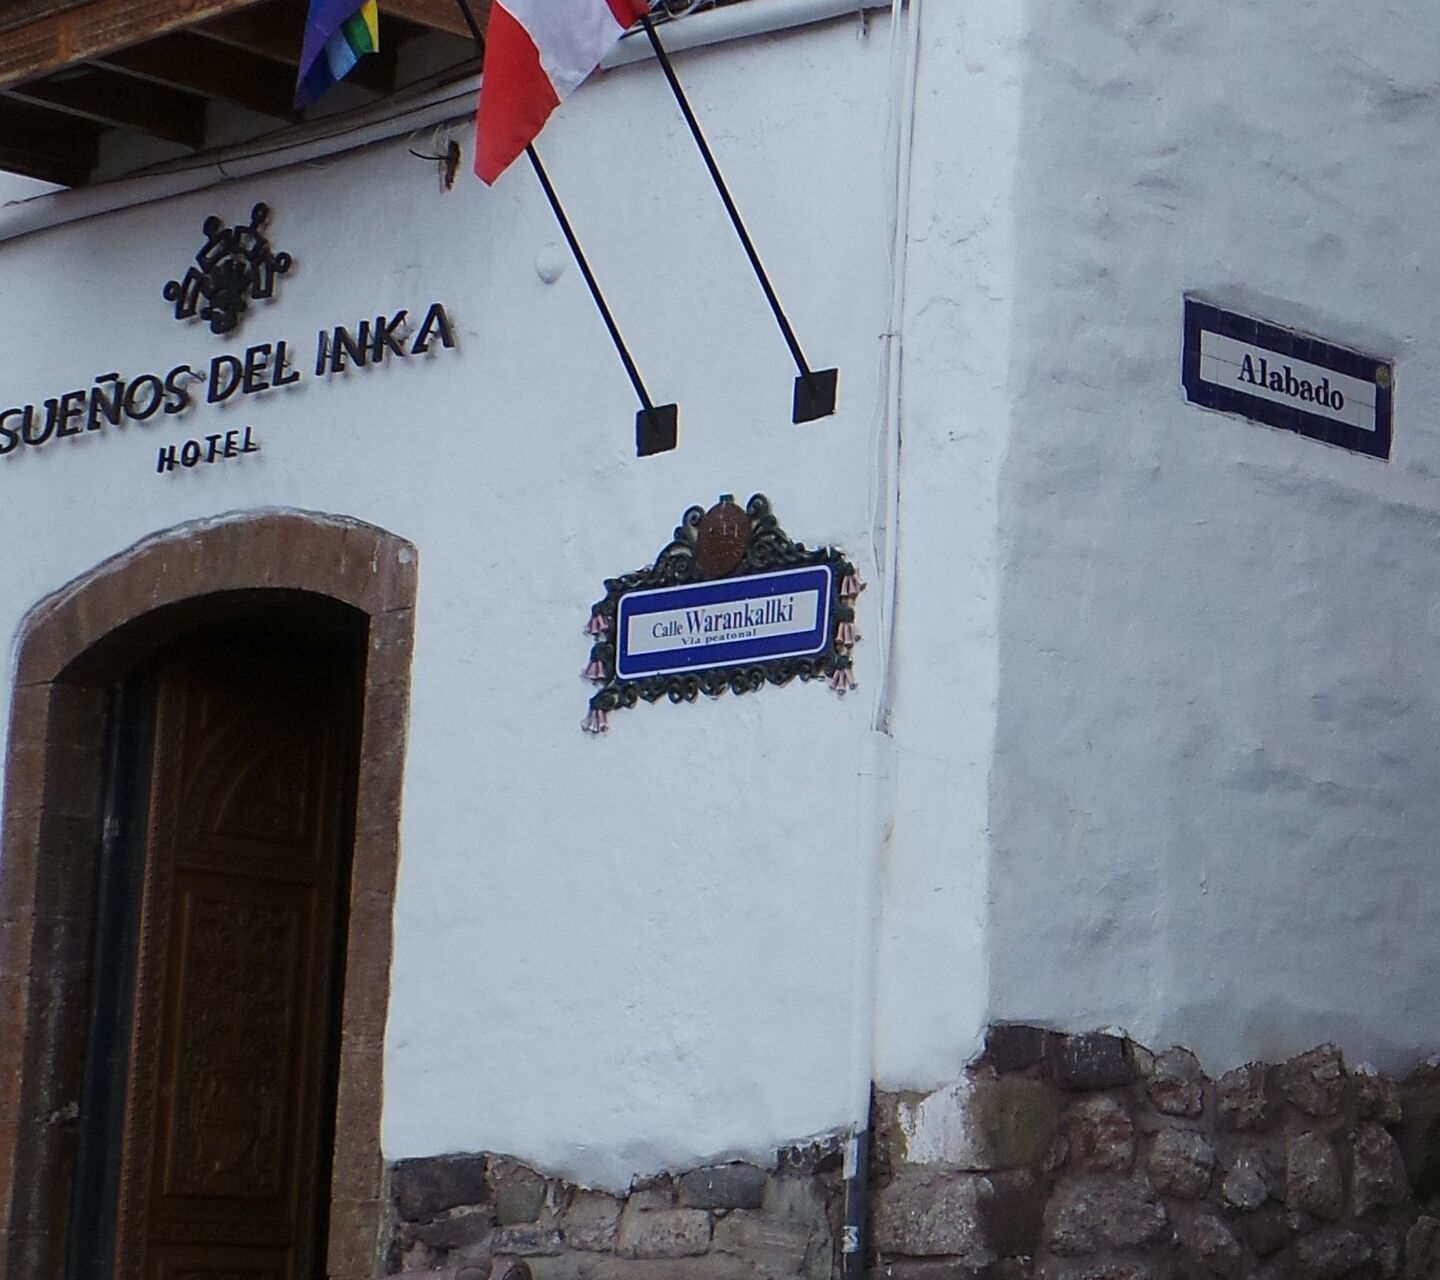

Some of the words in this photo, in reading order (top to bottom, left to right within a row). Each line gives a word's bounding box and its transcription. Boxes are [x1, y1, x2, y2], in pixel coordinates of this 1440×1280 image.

[0, 364, 193, 455] SUEÑOS
[207, 340, 300, 404] DEL
[315, 303, 456, 376] INKA
[1237, 353, 1344, 411] Alabado
[157, 426, 261, 473] HOTEL
[652, 621, 684, 639] Calle
[686, 596, 794, 635] Warankallki
[705, 627, 757, 645] peatonal
